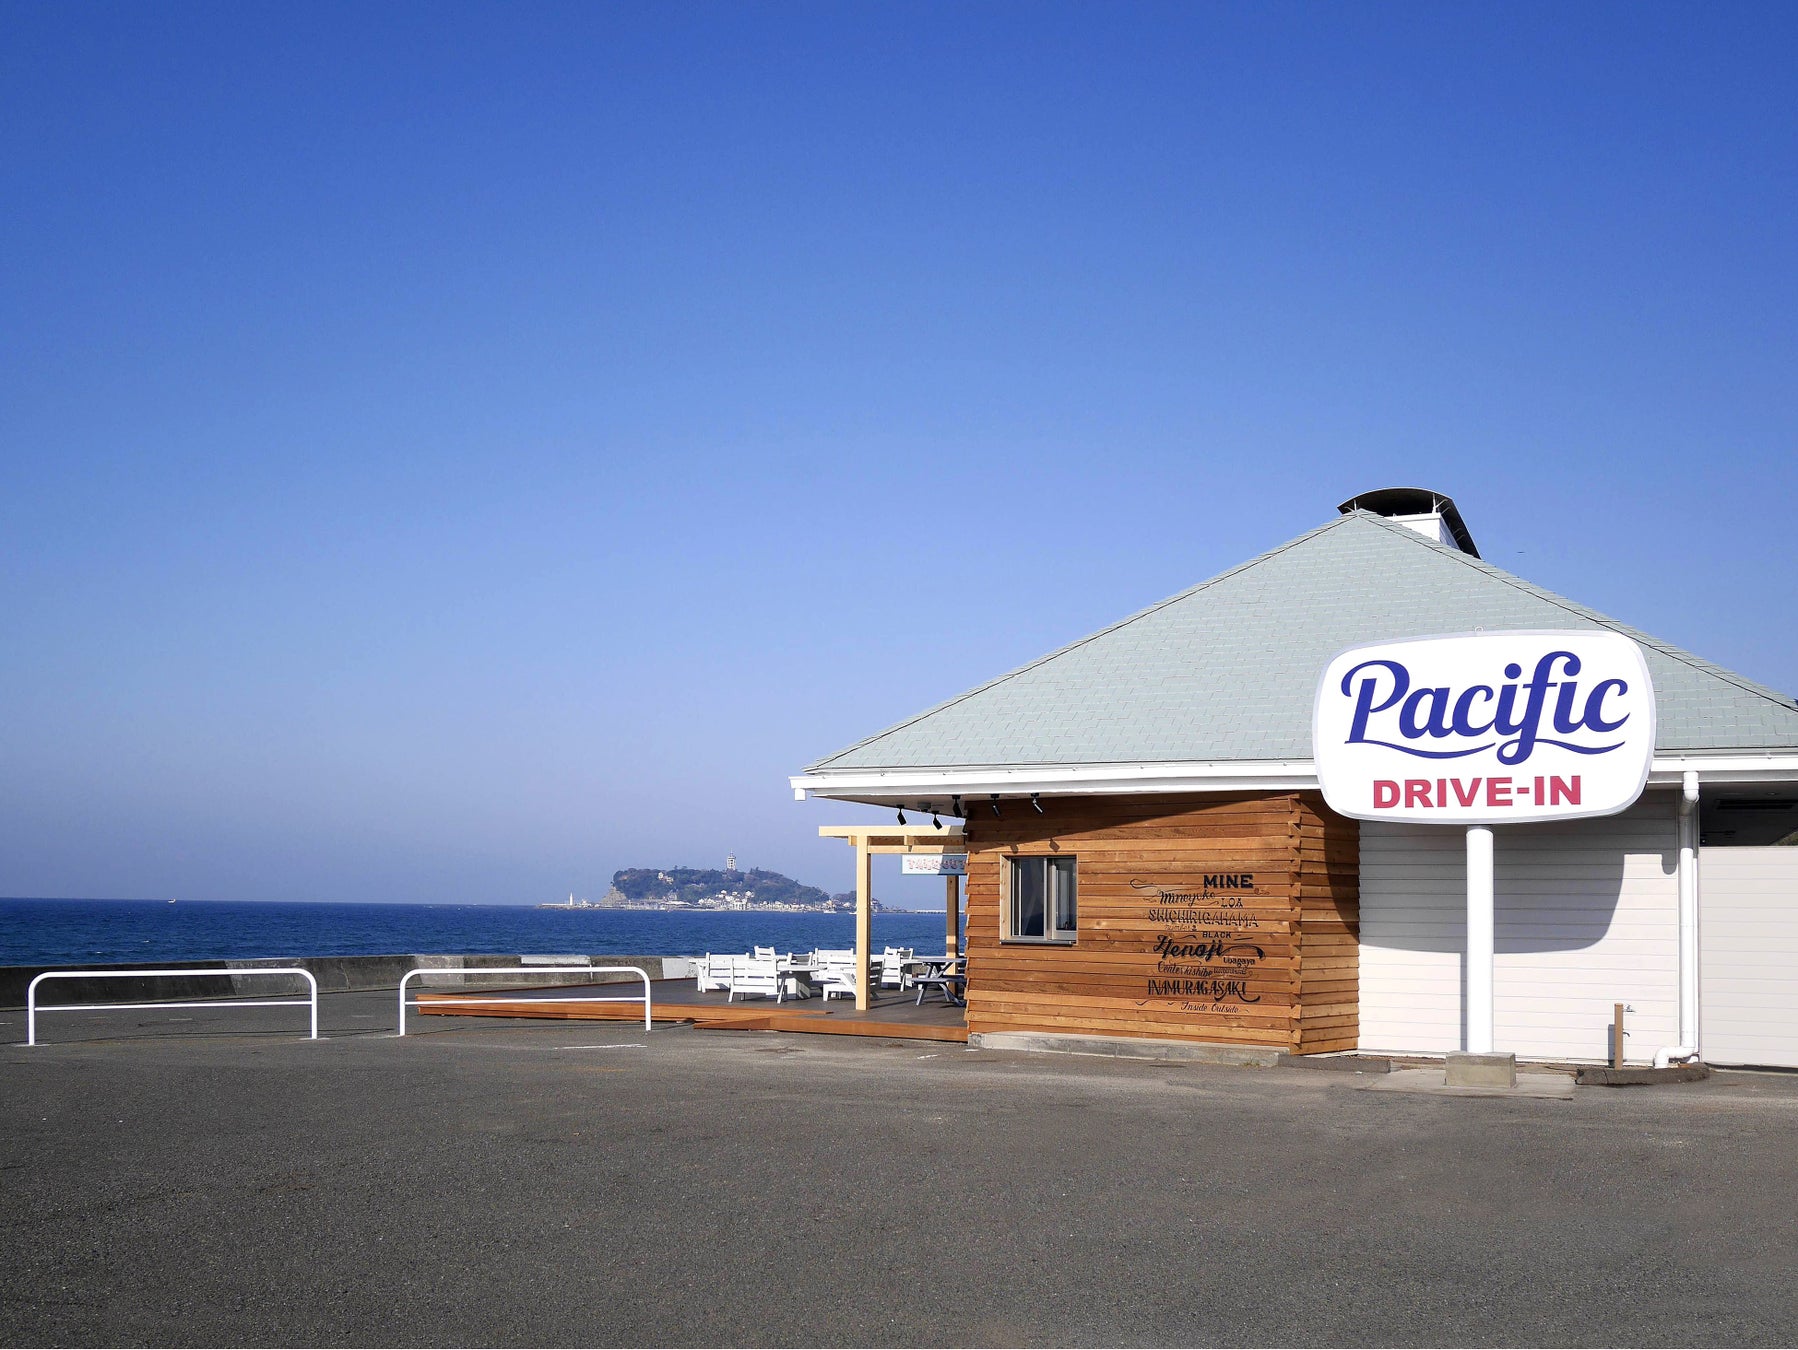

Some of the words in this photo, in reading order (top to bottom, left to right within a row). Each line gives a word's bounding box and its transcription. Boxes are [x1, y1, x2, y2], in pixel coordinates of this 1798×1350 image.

[1341, 650, 1630, 765] Pacific
[1373, 775, 1581, 808] DRIVE-IN
[1203, 874, 1254, 889] MINE
[1149, 909, 1259, 928] SHICHIRIGAHAMA
[1202, 931, 1231, 939] BLACK
[1148, 980, 1260, 1002] INAMURAGASAKI
